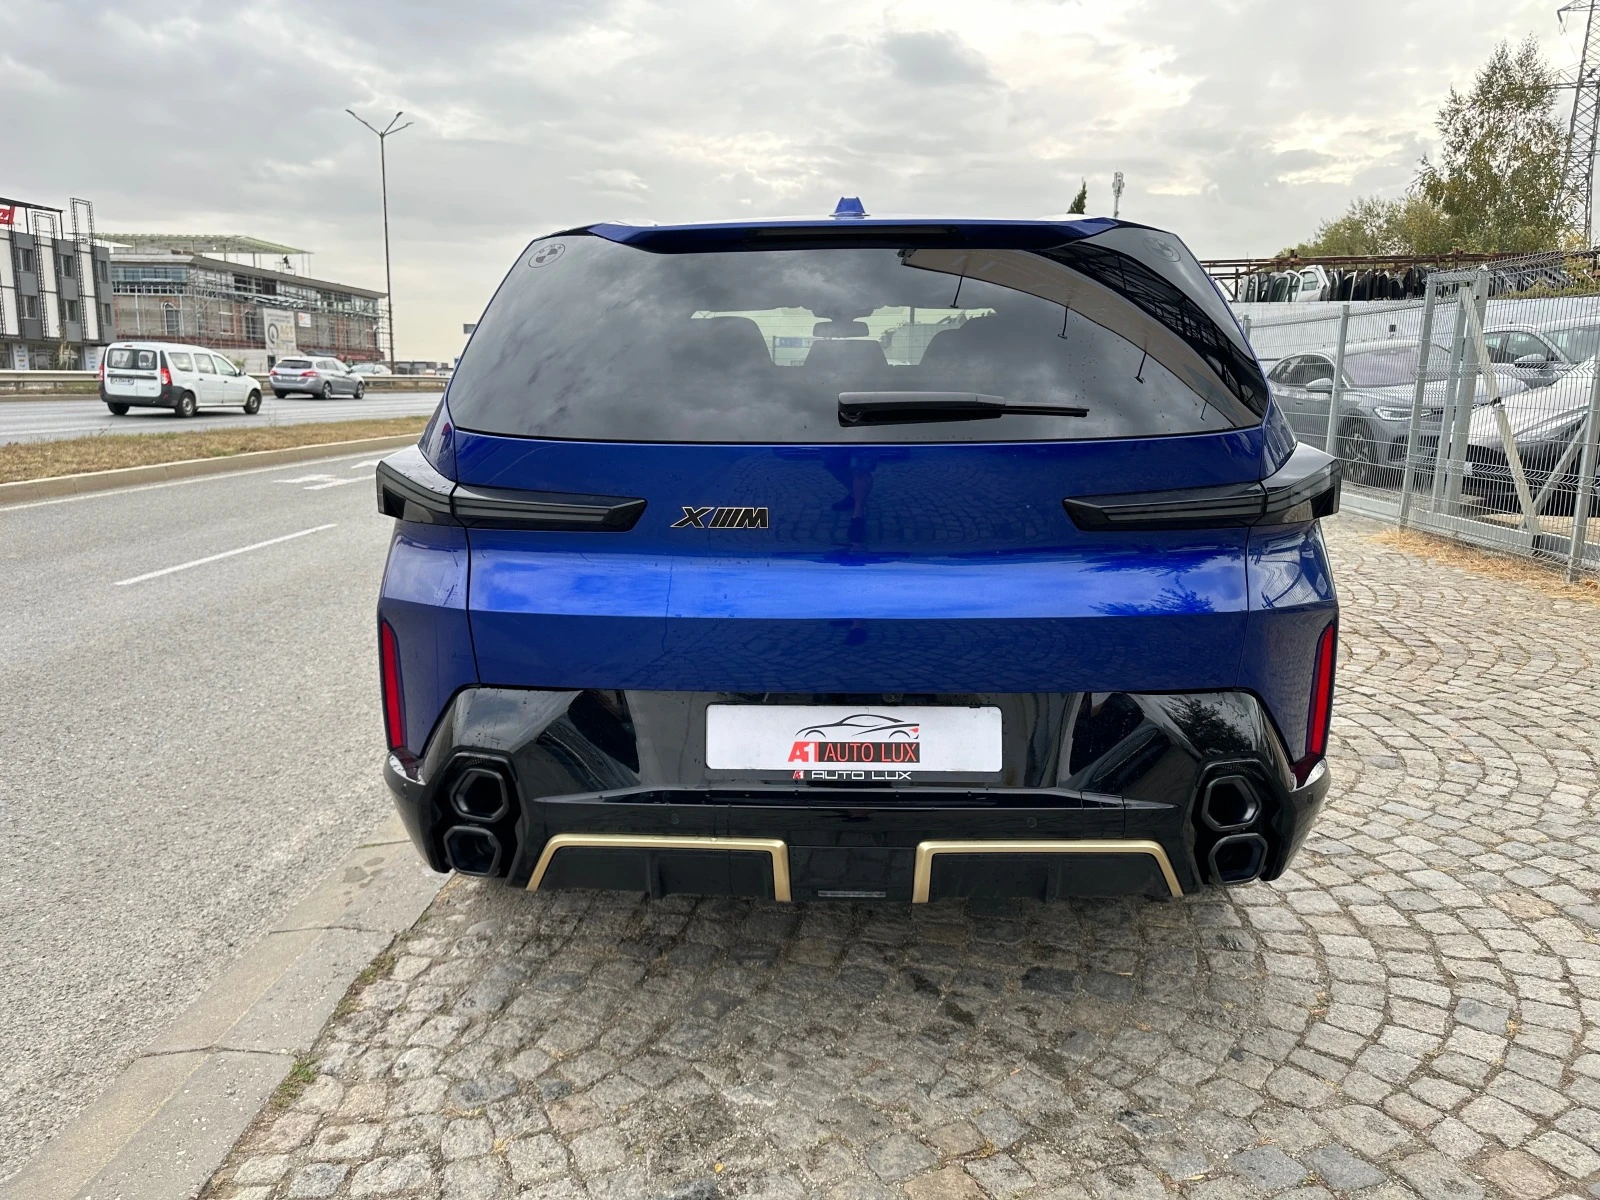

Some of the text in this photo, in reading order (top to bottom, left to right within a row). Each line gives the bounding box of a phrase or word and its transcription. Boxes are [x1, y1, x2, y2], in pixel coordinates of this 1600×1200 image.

[788, 741, 917, 762] A1 AUTO LUX
[792, 770, 912, 780] A1 AUTO LUX
